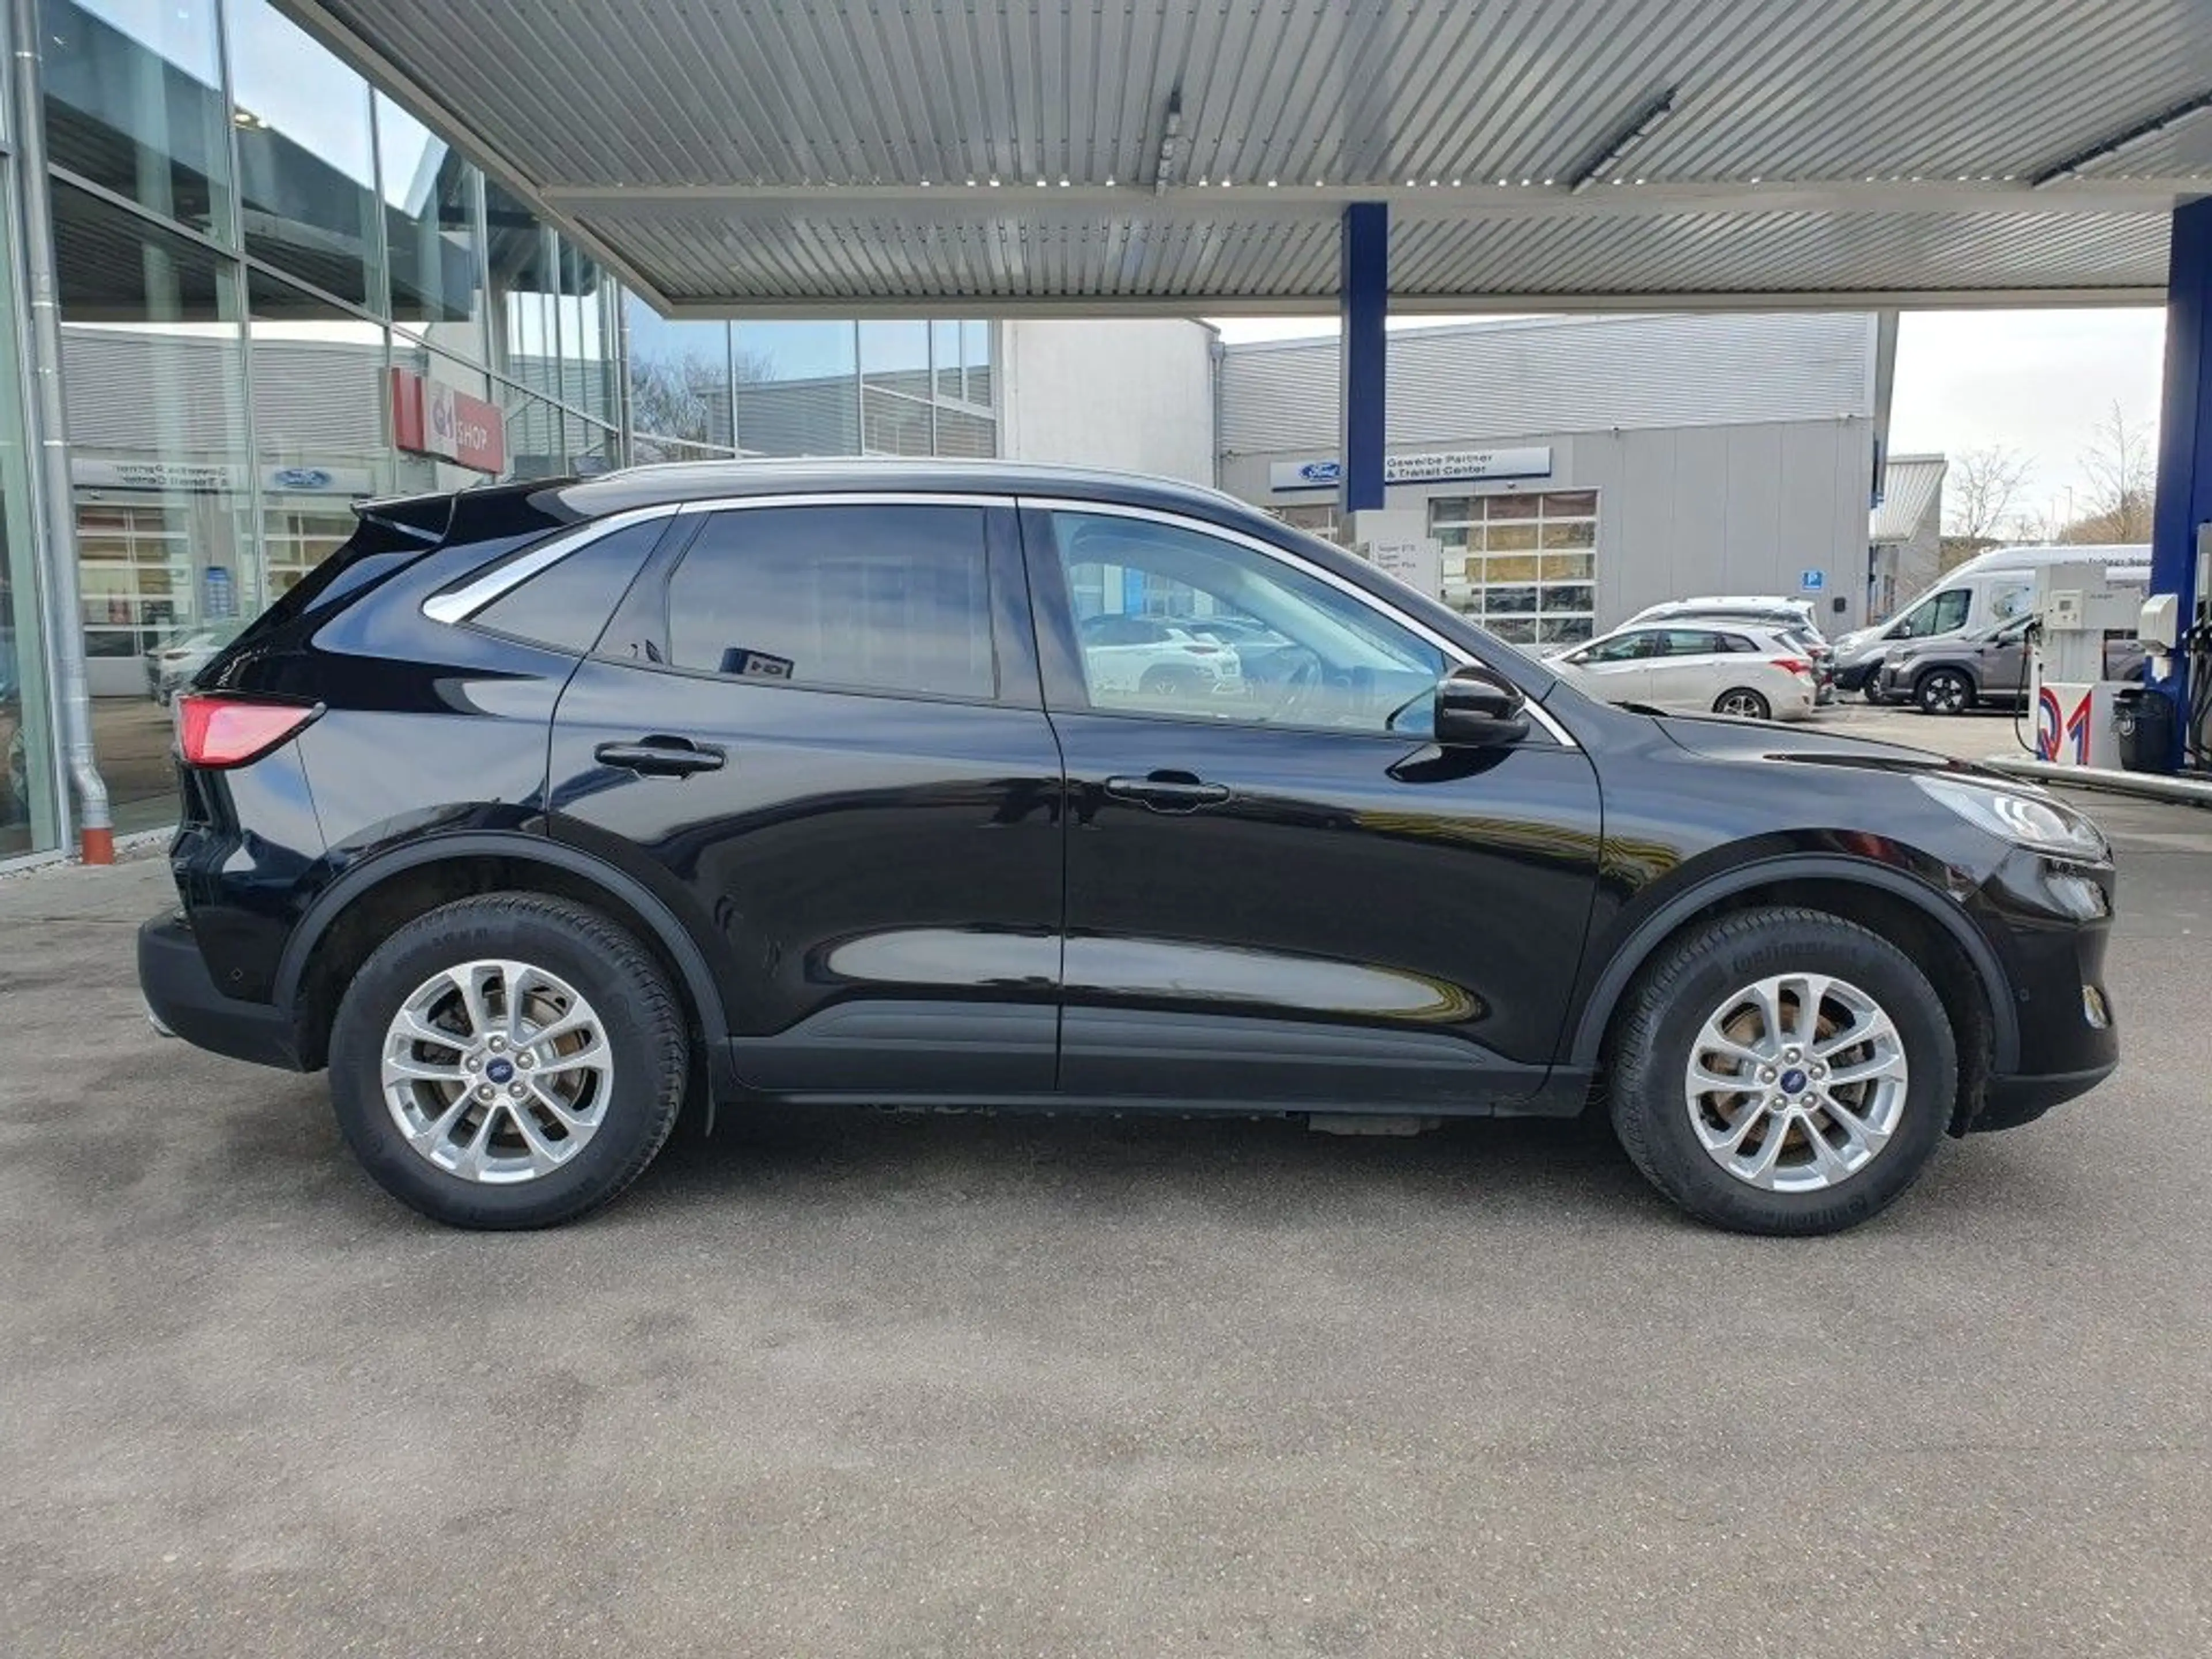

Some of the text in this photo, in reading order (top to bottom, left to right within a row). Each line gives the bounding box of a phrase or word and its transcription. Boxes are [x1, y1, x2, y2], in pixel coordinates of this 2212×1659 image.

[1387, 454, 1492, 468] Gewerbe Partner
[1387, 465, 1486, 478] & Transit Center
